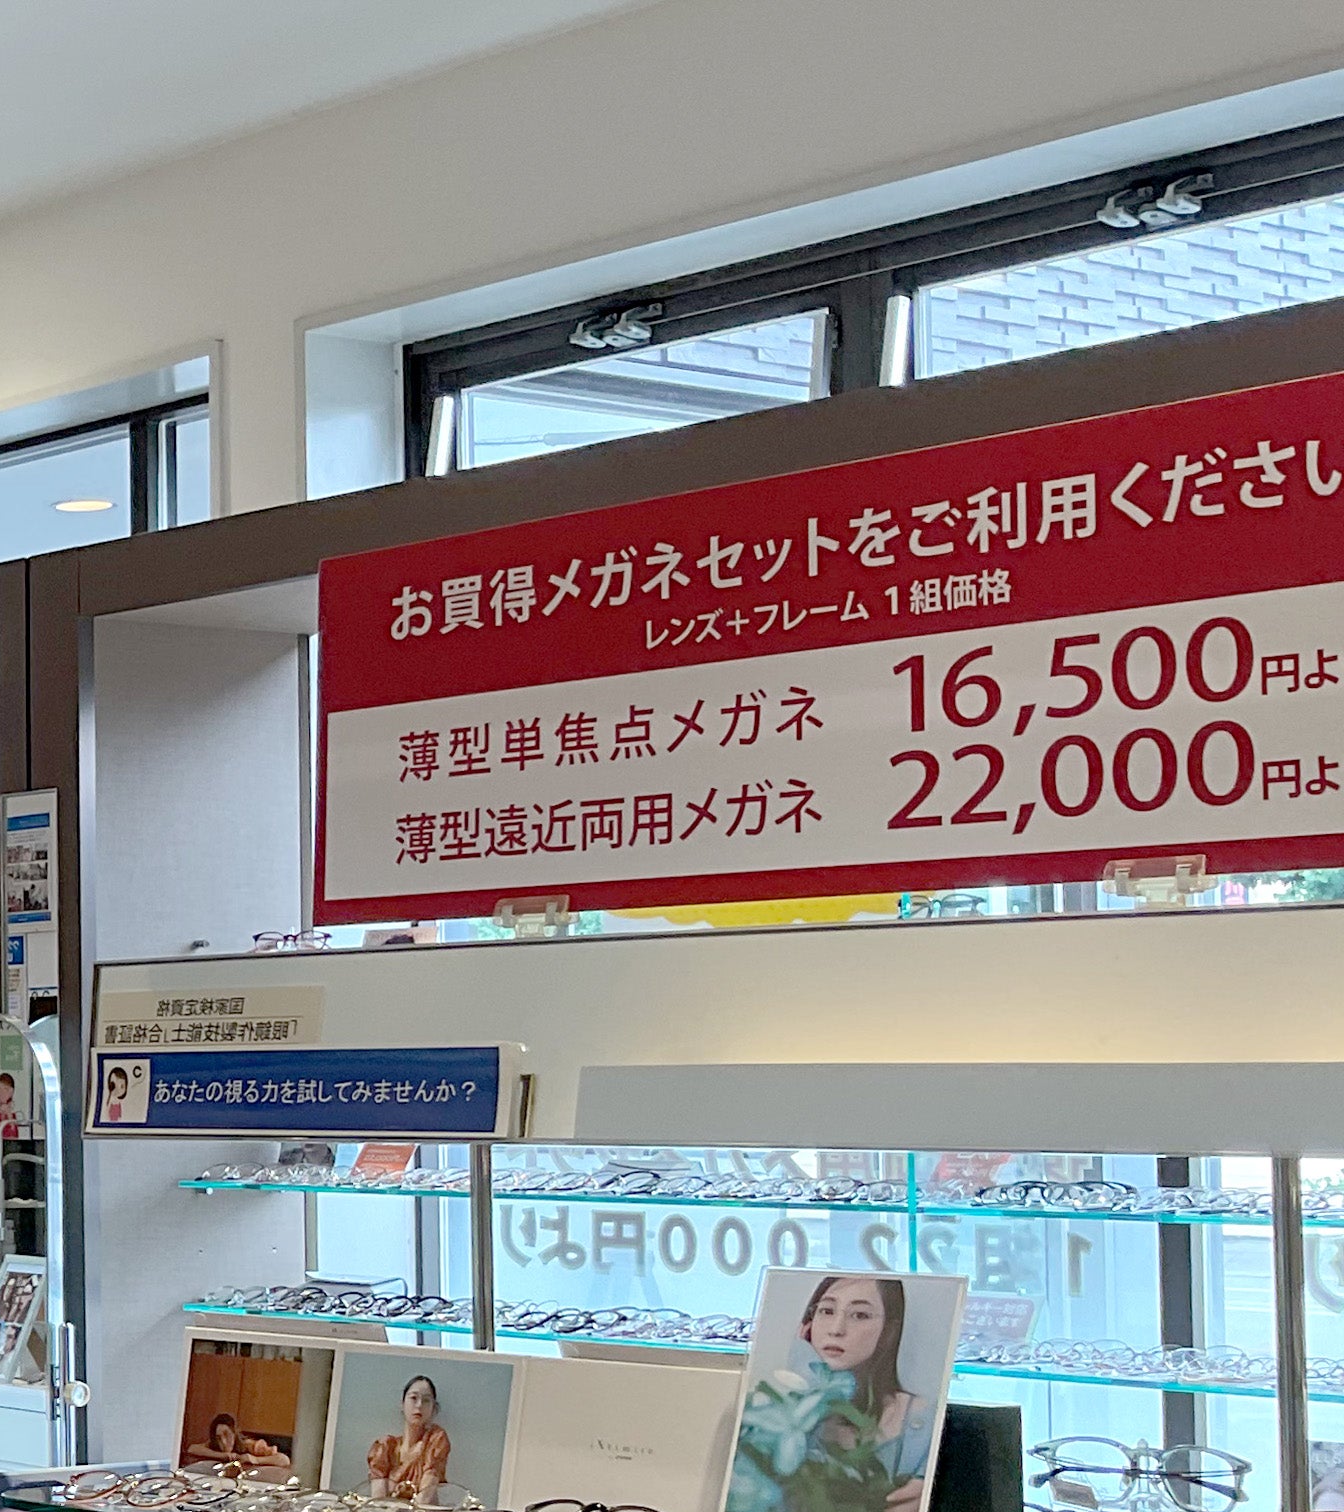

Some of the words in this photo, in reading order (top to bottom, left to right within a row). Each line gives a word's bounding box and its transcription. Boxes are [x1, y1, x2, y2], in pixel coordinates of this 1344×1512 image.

[399, 686, 824, 782] 薄型単焦点メガネ
[395, 778, 823, 865] 薄型遠近両用メガネ
